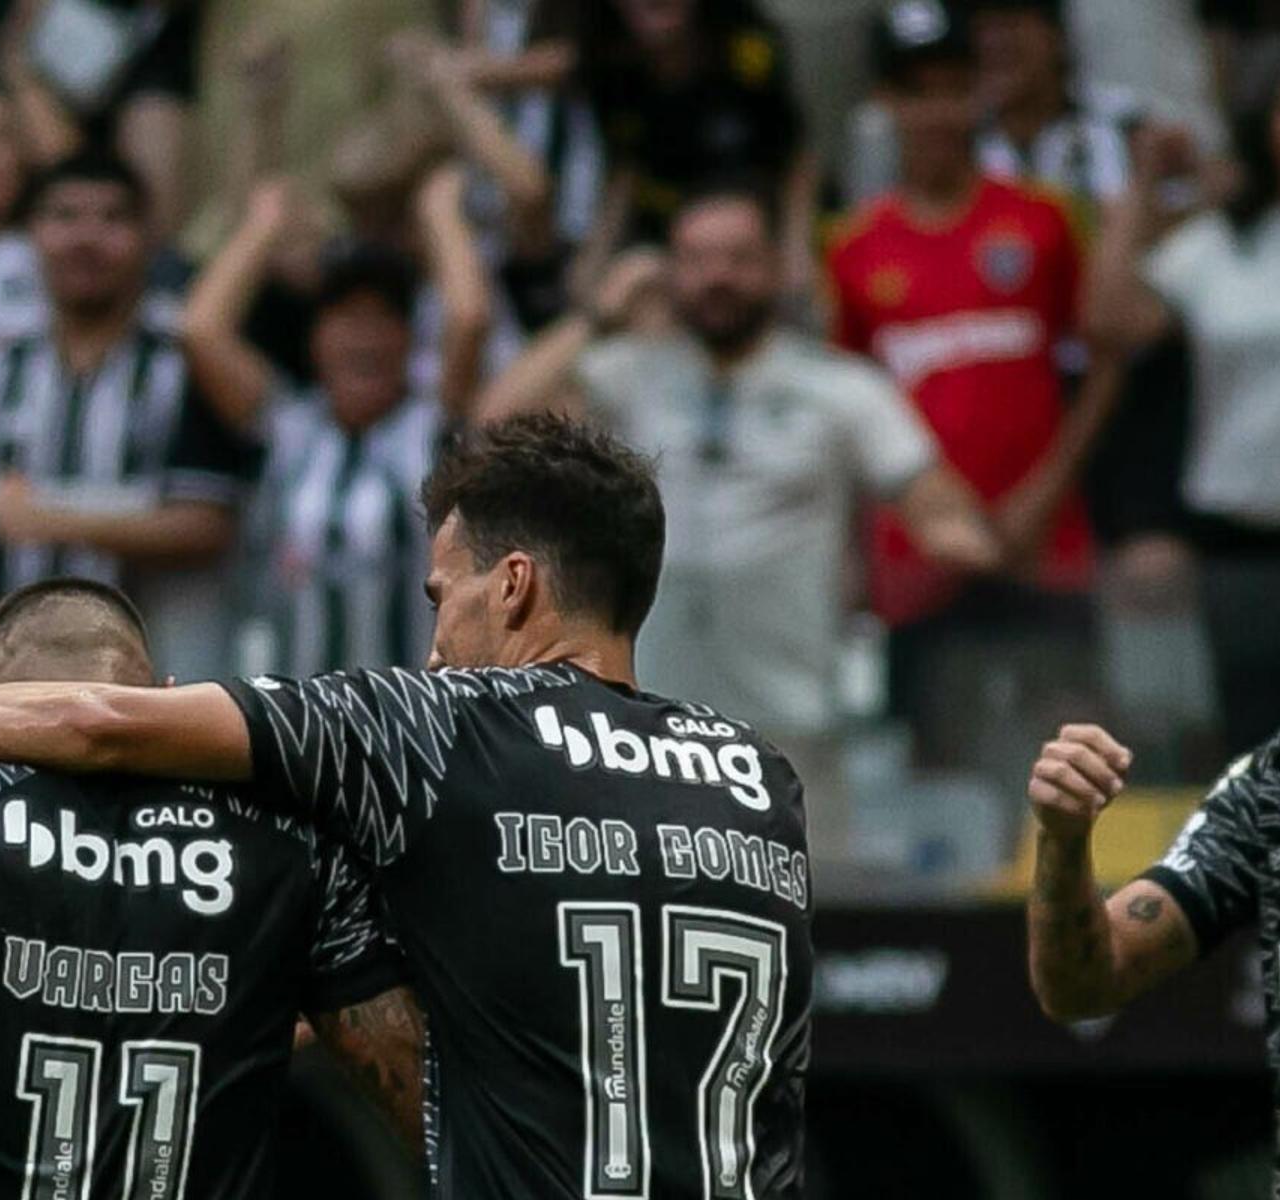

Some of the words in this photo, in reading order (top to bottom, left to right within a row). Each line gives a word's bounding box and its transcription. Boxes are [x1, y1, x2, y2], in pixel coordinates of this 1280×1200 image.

[590, 712, 771, 812] bmg
[667, 715, 736, 738] GALO
[136, 806, 215, 828] GALO
[494, 812, 641, 876] IGOR
[656, 823, 808, 910] GOMES
[60, 808, 234, 915] bmg
[3, 936, 229, 1015] VARGAS
